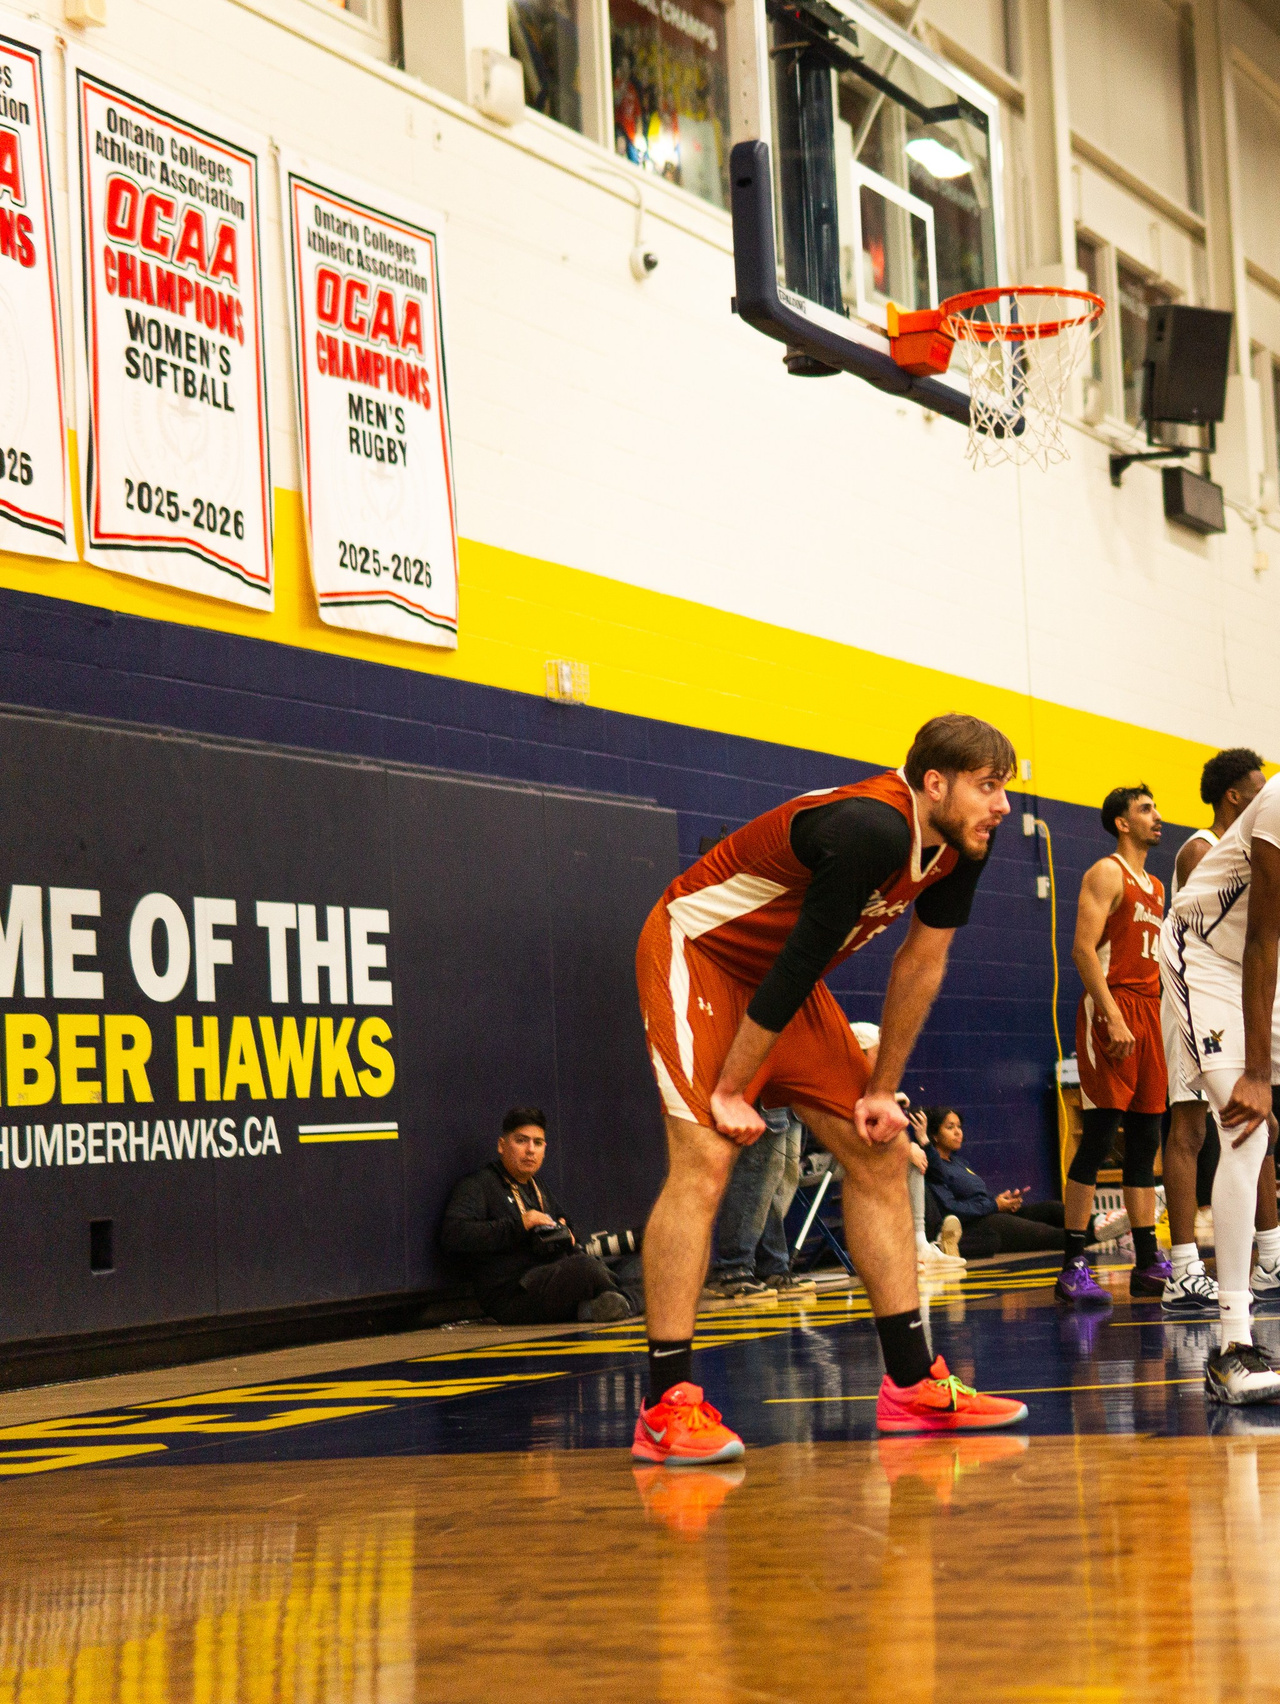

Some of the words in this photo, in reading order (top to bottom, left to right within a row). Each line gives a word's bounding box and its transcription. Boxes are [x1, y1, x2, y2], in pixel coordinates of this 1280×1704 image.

[0, 65, 13, 89] s
[95, 130, 156, 180] Athletic
[160, 161, 245, 220] Association
[107, 107, 164, 156] Ontario
[170, 137, 233, 187] Colleges
[104, 173, 240, 290] OCAA
[307, 226, 354, 266] Athletic
[357, 248, 427, 294] Association
[314, 204, 359, 243] Ontario
[363, 225, 417, 265] Colleges
[103, 245, 245, 347] CHAMPIONS
[315, 263, 425, 361] OCAA
[125, 309, 231, 376] WOMEN'S
[315, 331, 431, 411] CHAMPIONS
[125, 346, 234, 413] SOFTBALL
[348, 392, 406, 434] MEN'S
[348, 426, 407, 466] RUGBY
[125, 478, 245, 540] 2025-2026
[338, 540, 432, 588] 2025-2026
[0, 884, 104, 999] ME
[130, 892, 237, 1002] OF
[256, 900, 393, 1006] THE
[1141, 929, 1160, 963] 14
[4, 1012, 154, 1107] BER
[175, 1016, 396, 1102] HAWKS
